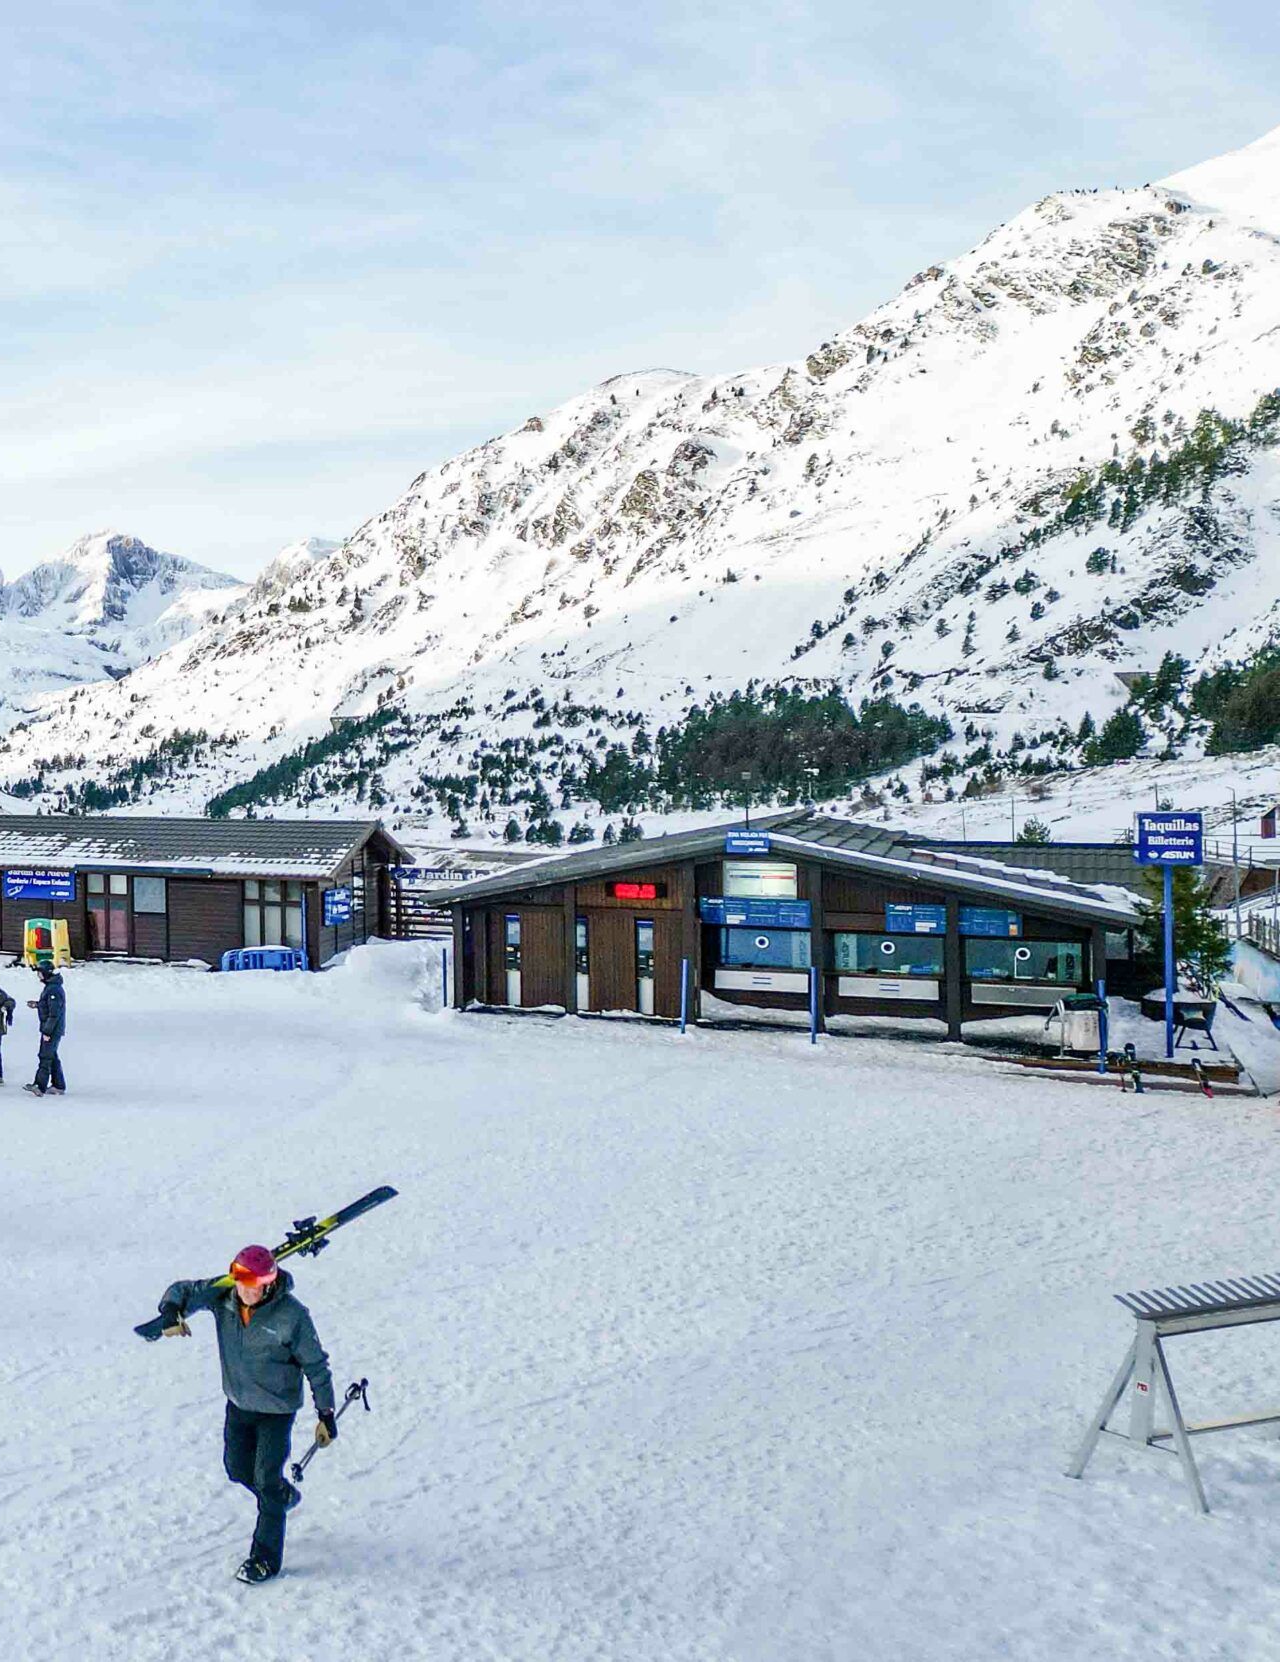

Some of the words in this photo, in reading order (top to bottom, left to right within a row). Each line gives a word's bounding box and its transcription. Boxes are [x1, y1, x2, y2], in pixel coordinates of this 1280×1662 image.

[1142, 818, 1200, 834] Taquillas
[1147, 836, 1195, 846] Billetterie
[1161, 850, 1195, 860] ASTUN
[417, 869, 463, 881] Jardín
